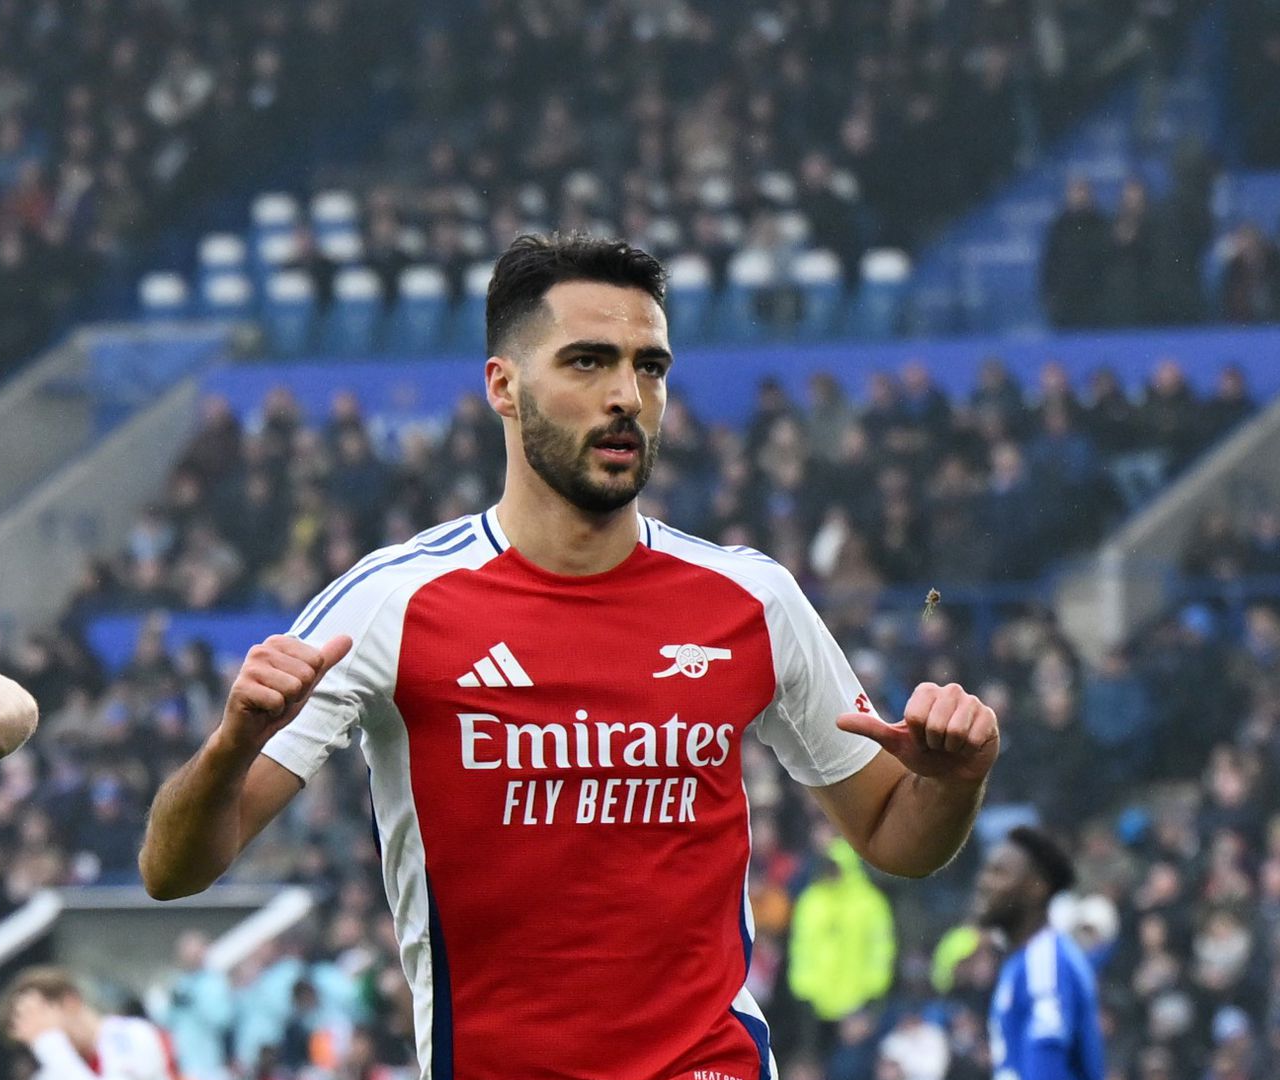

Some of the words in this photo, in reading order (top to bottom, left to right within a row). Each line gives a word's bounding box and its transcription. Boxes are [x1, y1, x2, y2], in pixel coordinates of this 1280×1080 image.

[456, 709, 734, 770] Emirates
[502, 779, 564, 825] FLY
[575, 776, 698, 824] BETTER
